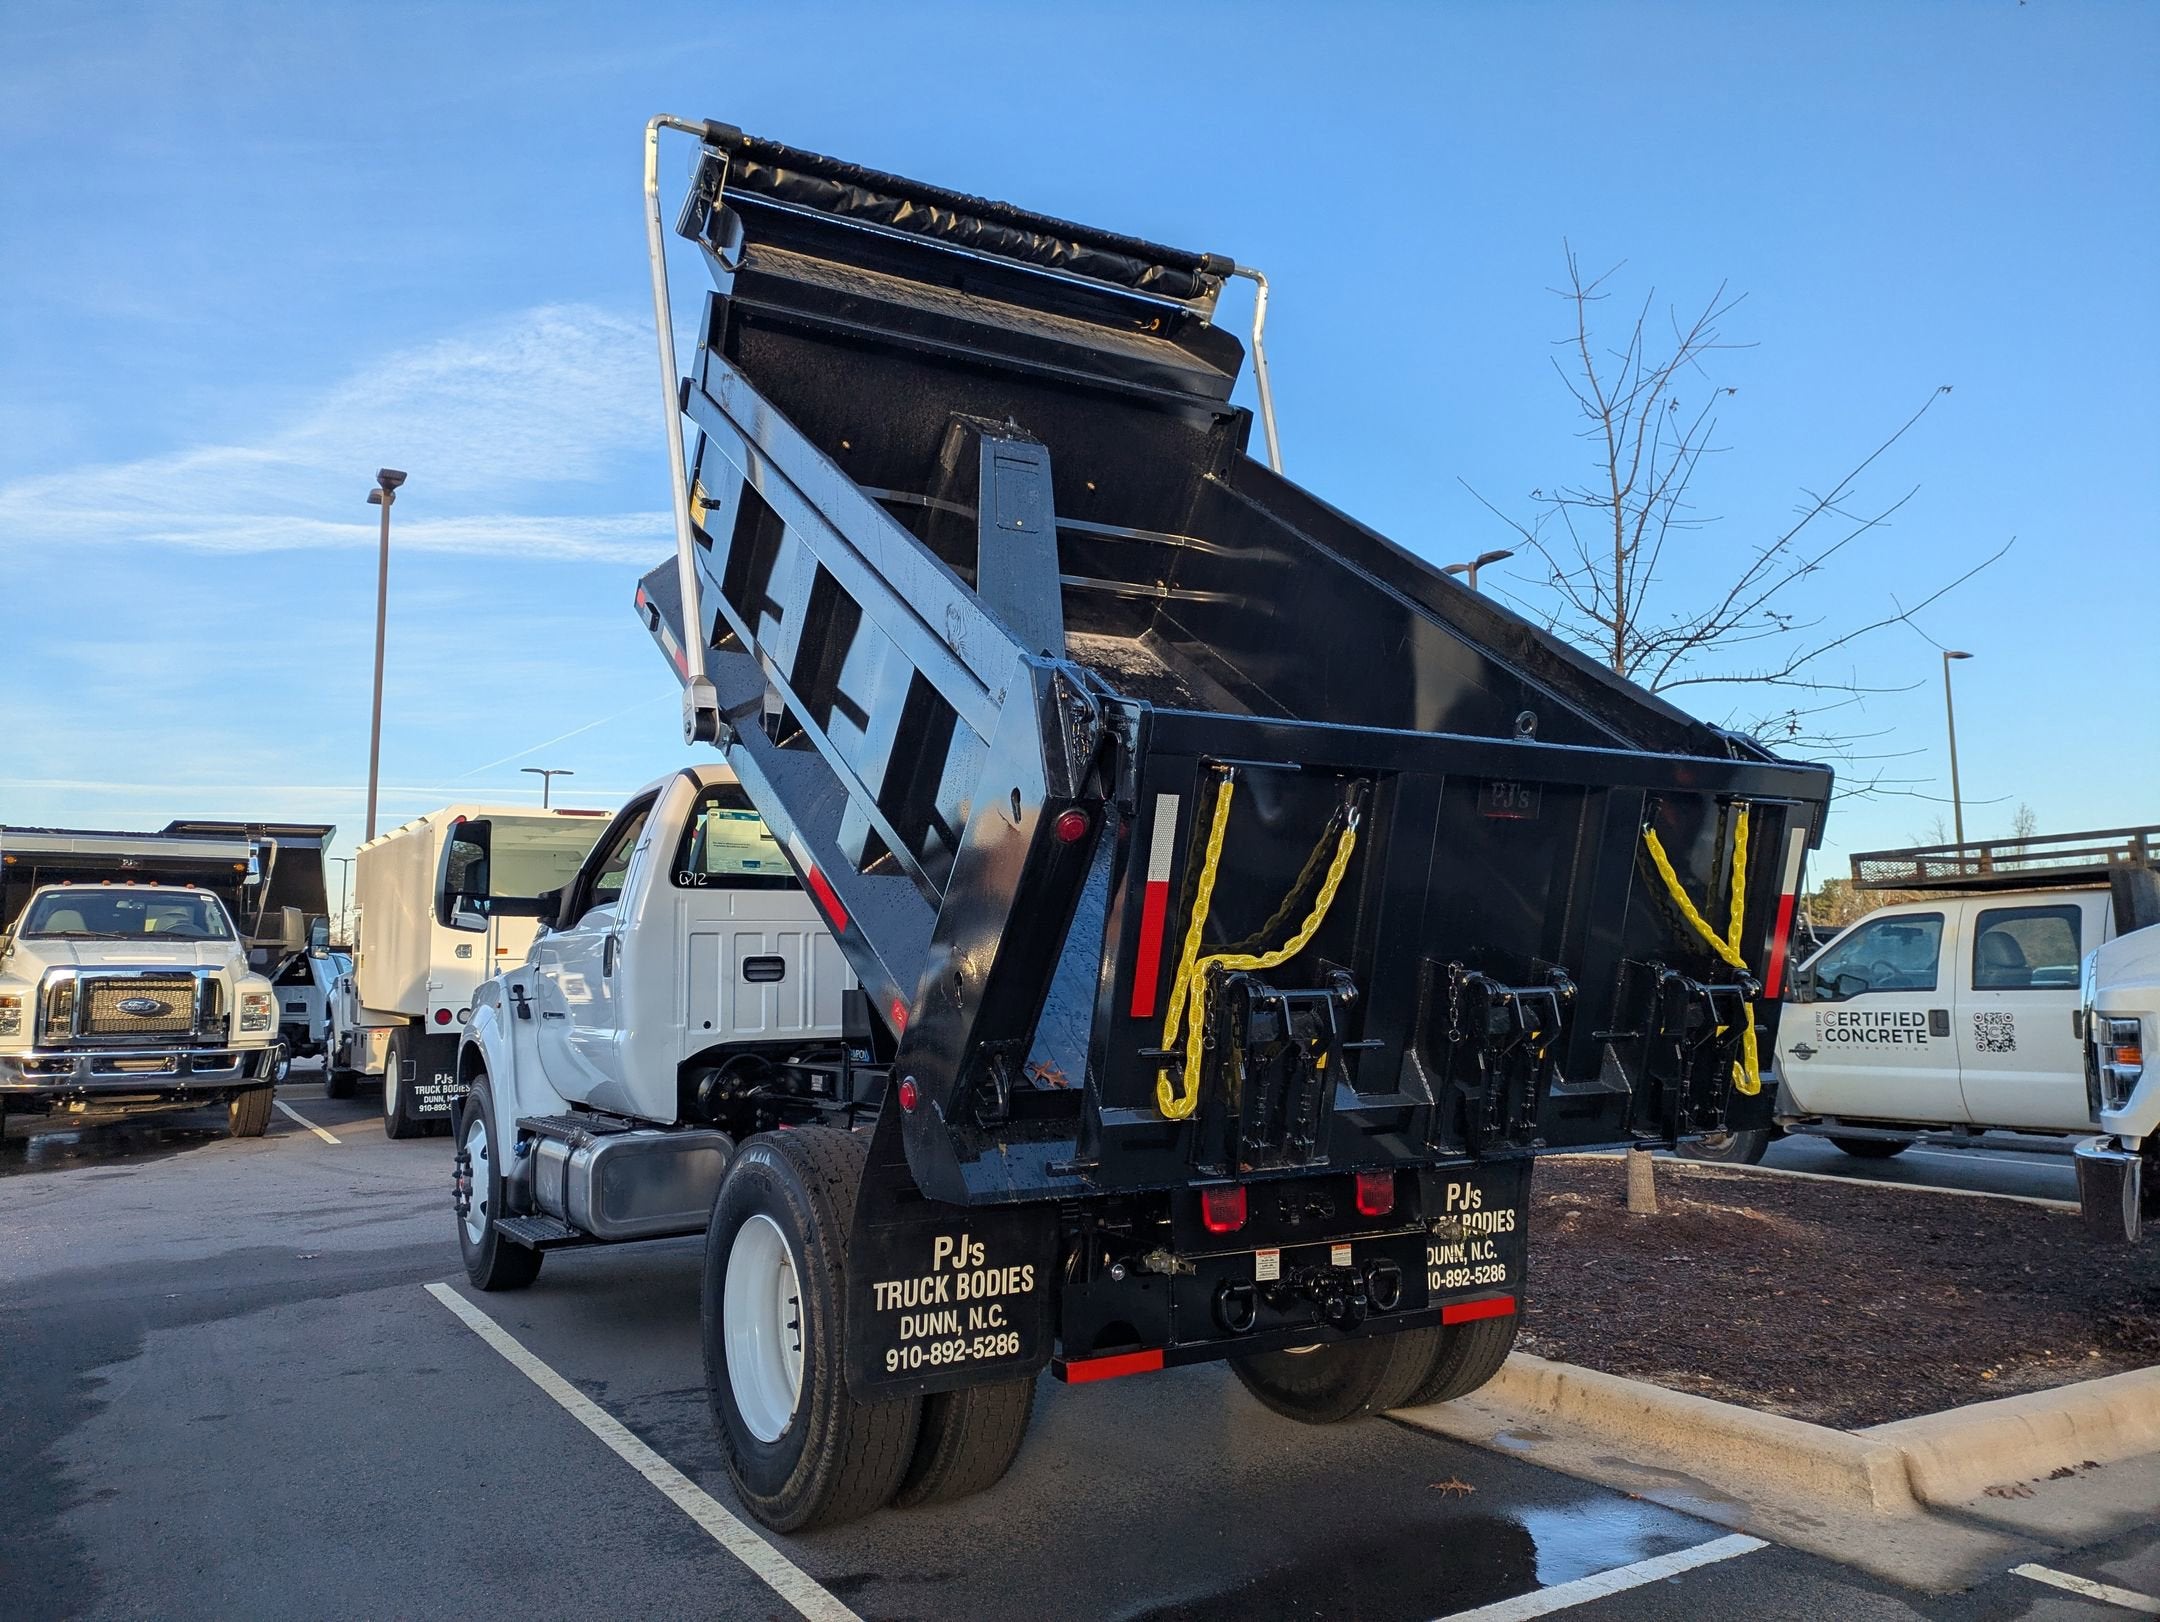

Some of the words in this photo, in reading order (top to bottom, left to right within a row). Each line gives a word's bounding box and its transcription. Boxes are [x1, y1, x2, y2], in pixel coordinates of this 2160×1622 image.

[1491, 782, 1530, 808] PJ's
[679, 871, 708, 885] Q12
[1823, 1010, 1926, 1027] CERTIFIED
[1825, 1028, 1928, 1044] CONCRETE
[414, 1085, 441, 1095] TRUCK
[442, 1084, 471, 1094] BODIES
[423, 1095, 446, 1104] DUNN,
[1446, 1182, 1482, 1212] PJ's
[1462, 1209, 1515, 1235] BODIES
[934, 1234, 985, 1272] PJ's
[1471, 1240, 1498, 1261] N.C.
[873, 1274, 950, 1311] TRUCK
[956, 1264, 1035, 1301] BODIES
[1427, 1263, 1507, 1290] 10-892-5286
[900, 1309, 963, 1340] DUNN,
[969, 1303, 1008, 1331] N.C.
[886, 1331, 1020, 1372] 910-892-5286
